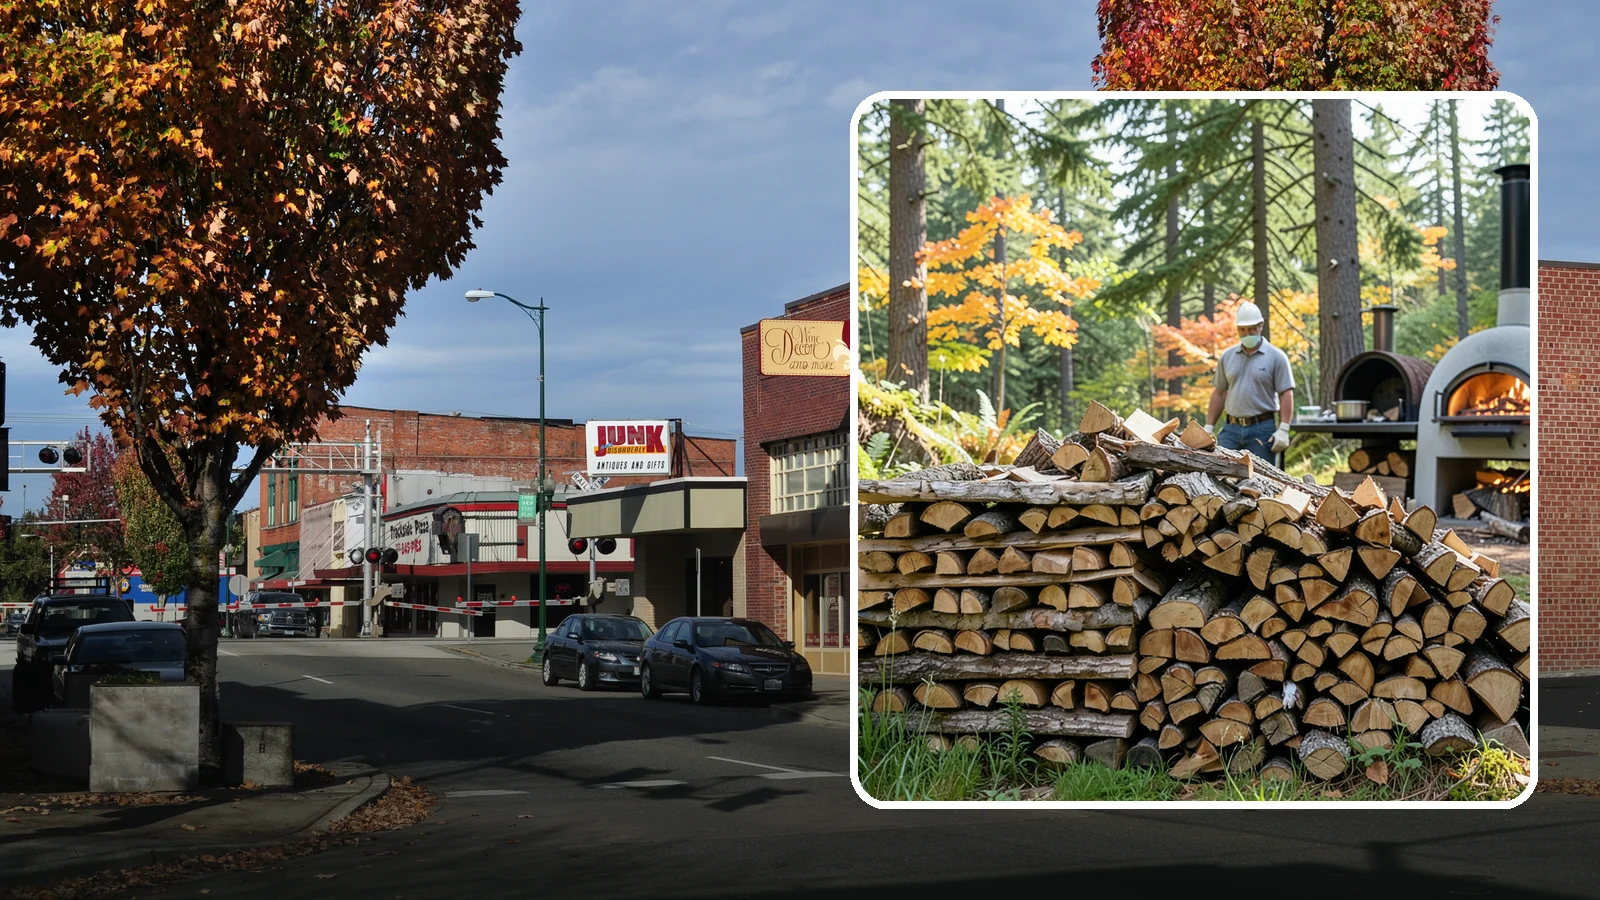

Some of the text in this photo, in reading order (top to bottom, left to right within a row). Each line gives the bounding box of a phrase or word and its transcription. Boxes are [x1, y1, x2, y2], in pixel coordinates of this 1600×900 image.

[765, 327, 831, 365] Decor
[596, 425, 664, 457] JUNK
[607, 446, 646, 454] DISORDERLY
[597, 460, 665, 470] ANTIQUES AND GIFTS
[390, 519, 429, 539] Trackside Pizza
